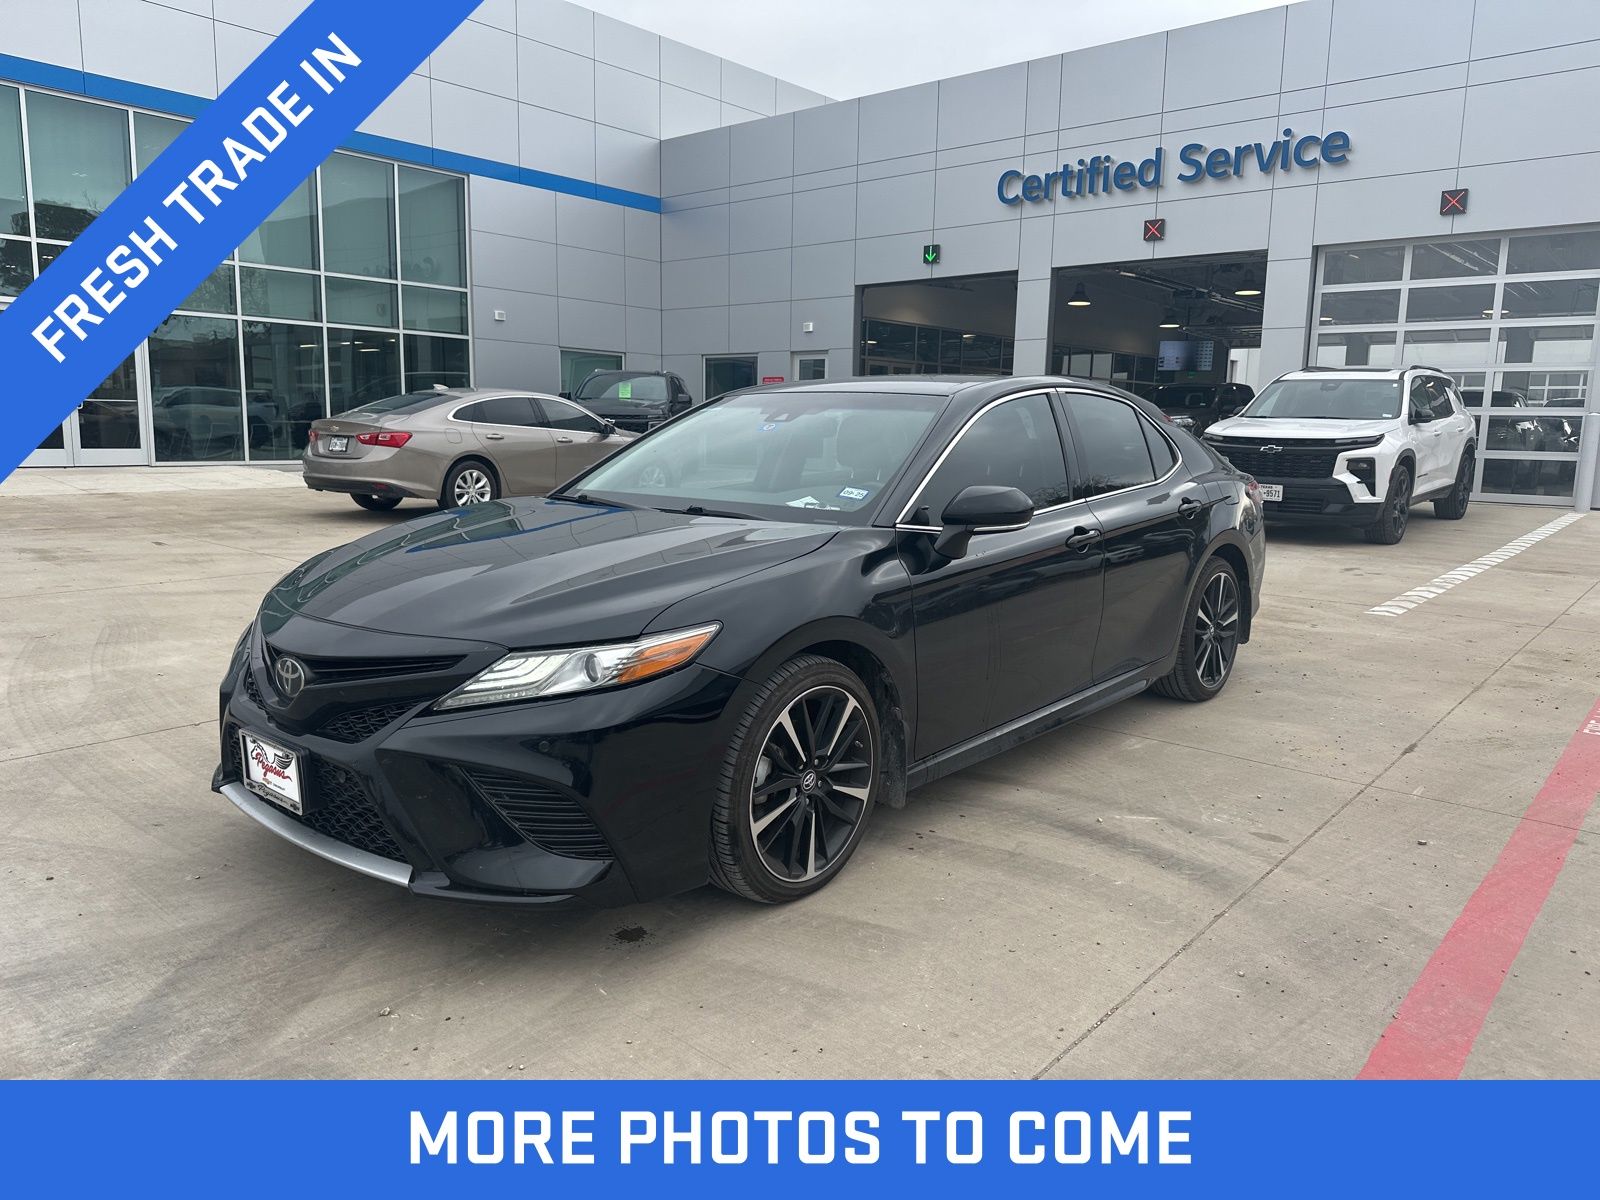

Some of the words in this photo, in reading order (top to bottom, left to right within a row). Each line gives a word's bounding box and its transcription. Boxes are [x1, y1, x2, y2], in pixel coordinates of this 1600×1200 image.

[997, 147, 1163, 206] Certified
[1177, 127, 1352, 184] Service
[255, 751, 293, 782] Pegasus
